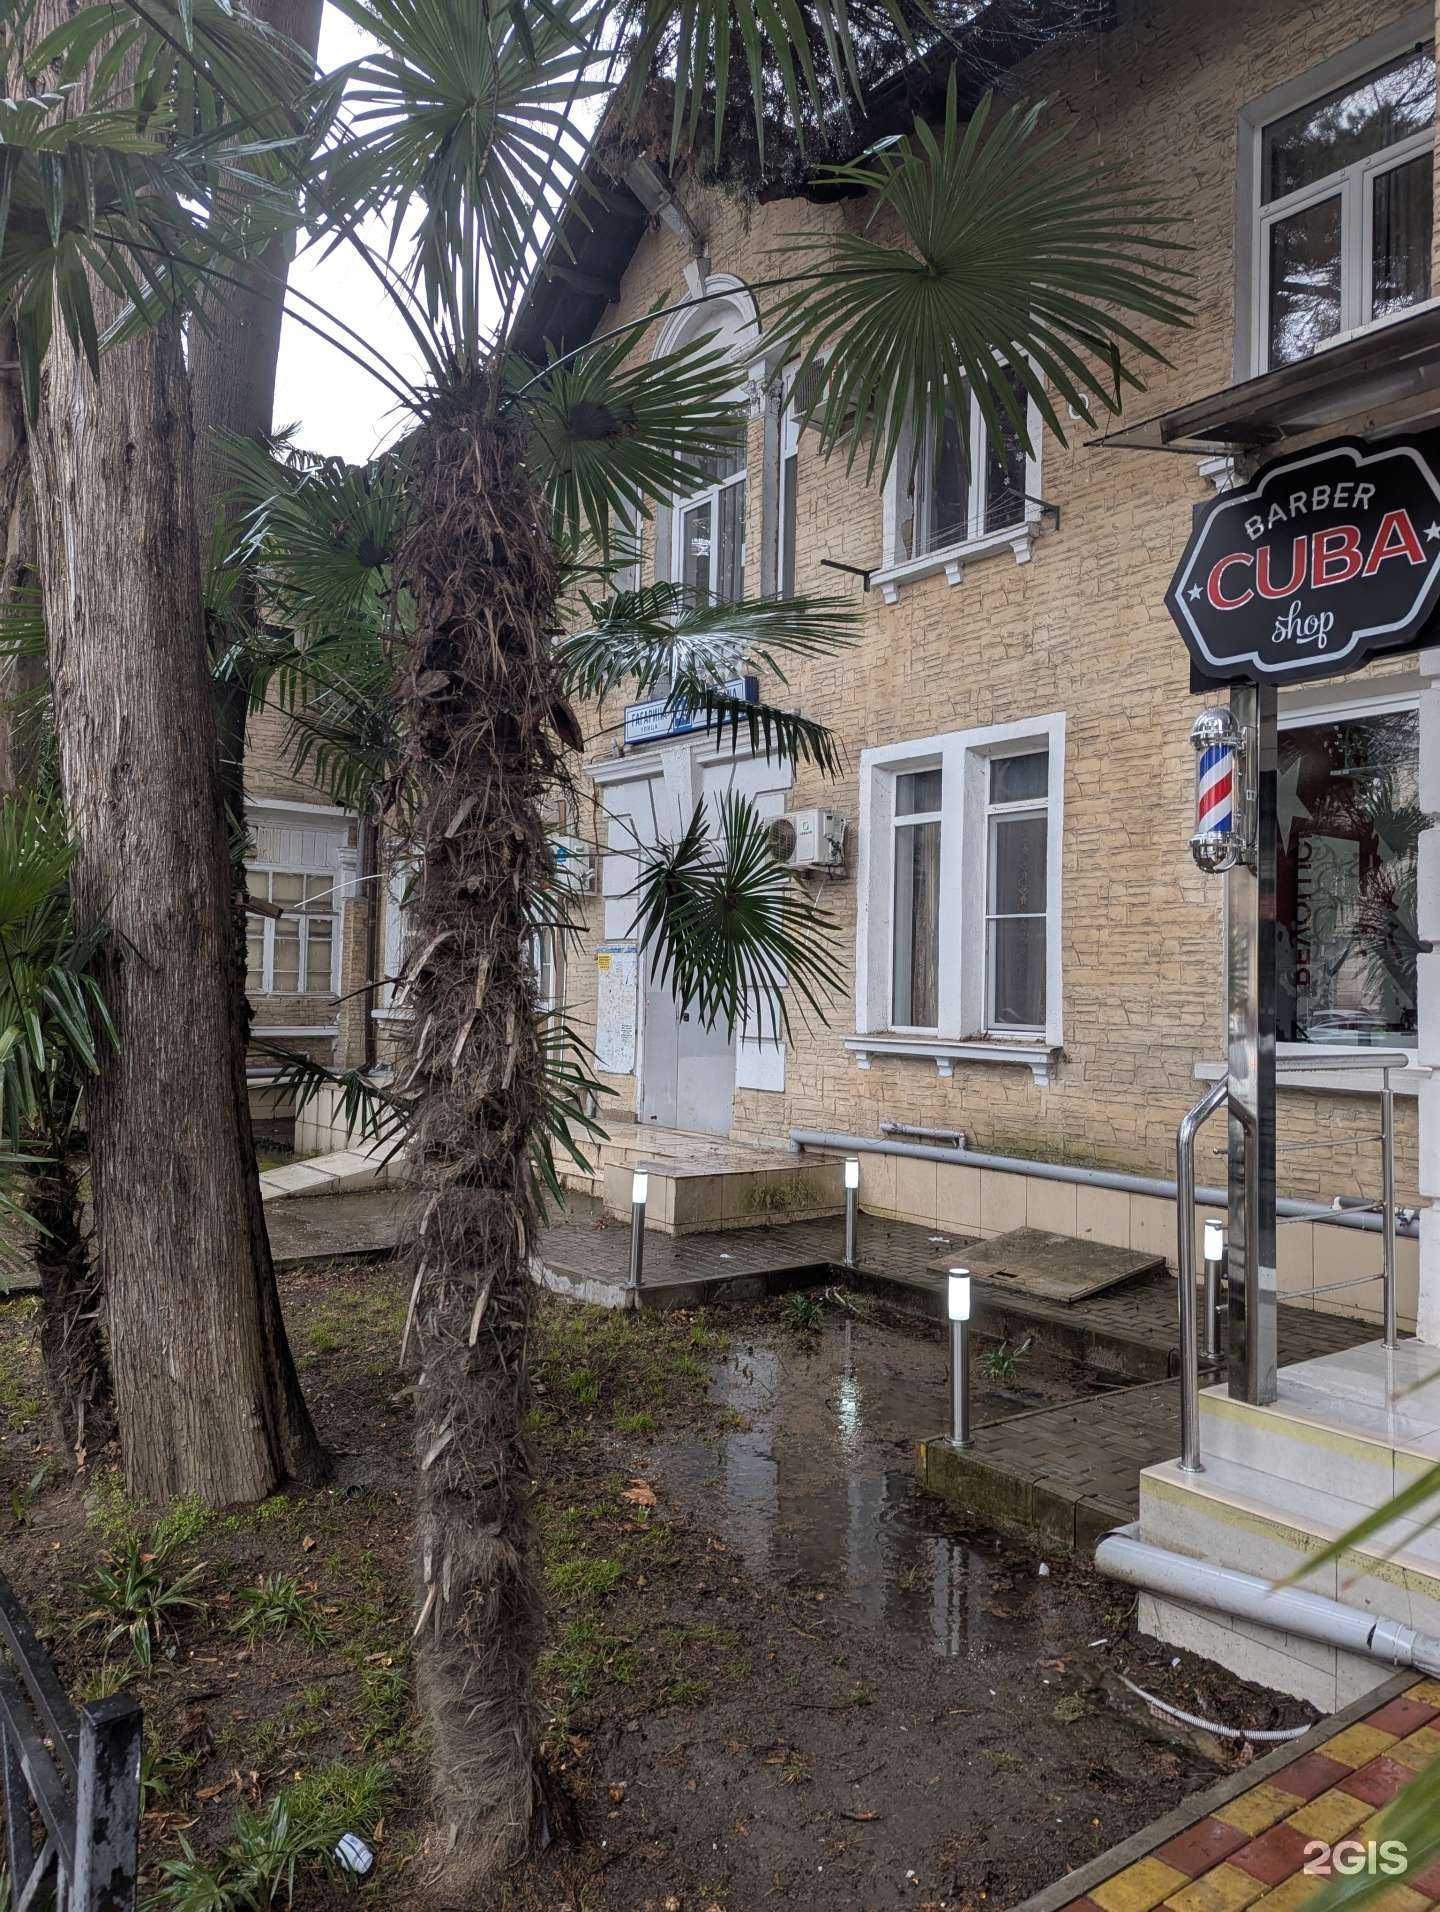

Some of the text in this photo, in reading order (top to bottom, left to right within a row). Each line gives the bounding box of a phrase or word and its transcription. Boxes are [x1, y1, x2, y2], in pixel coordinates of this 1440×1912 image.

[1243, 482, 1376, 541] BARBER
[1206, 508, 1428, 611] CUBA
[1271, 600, 1335, 649] shop
